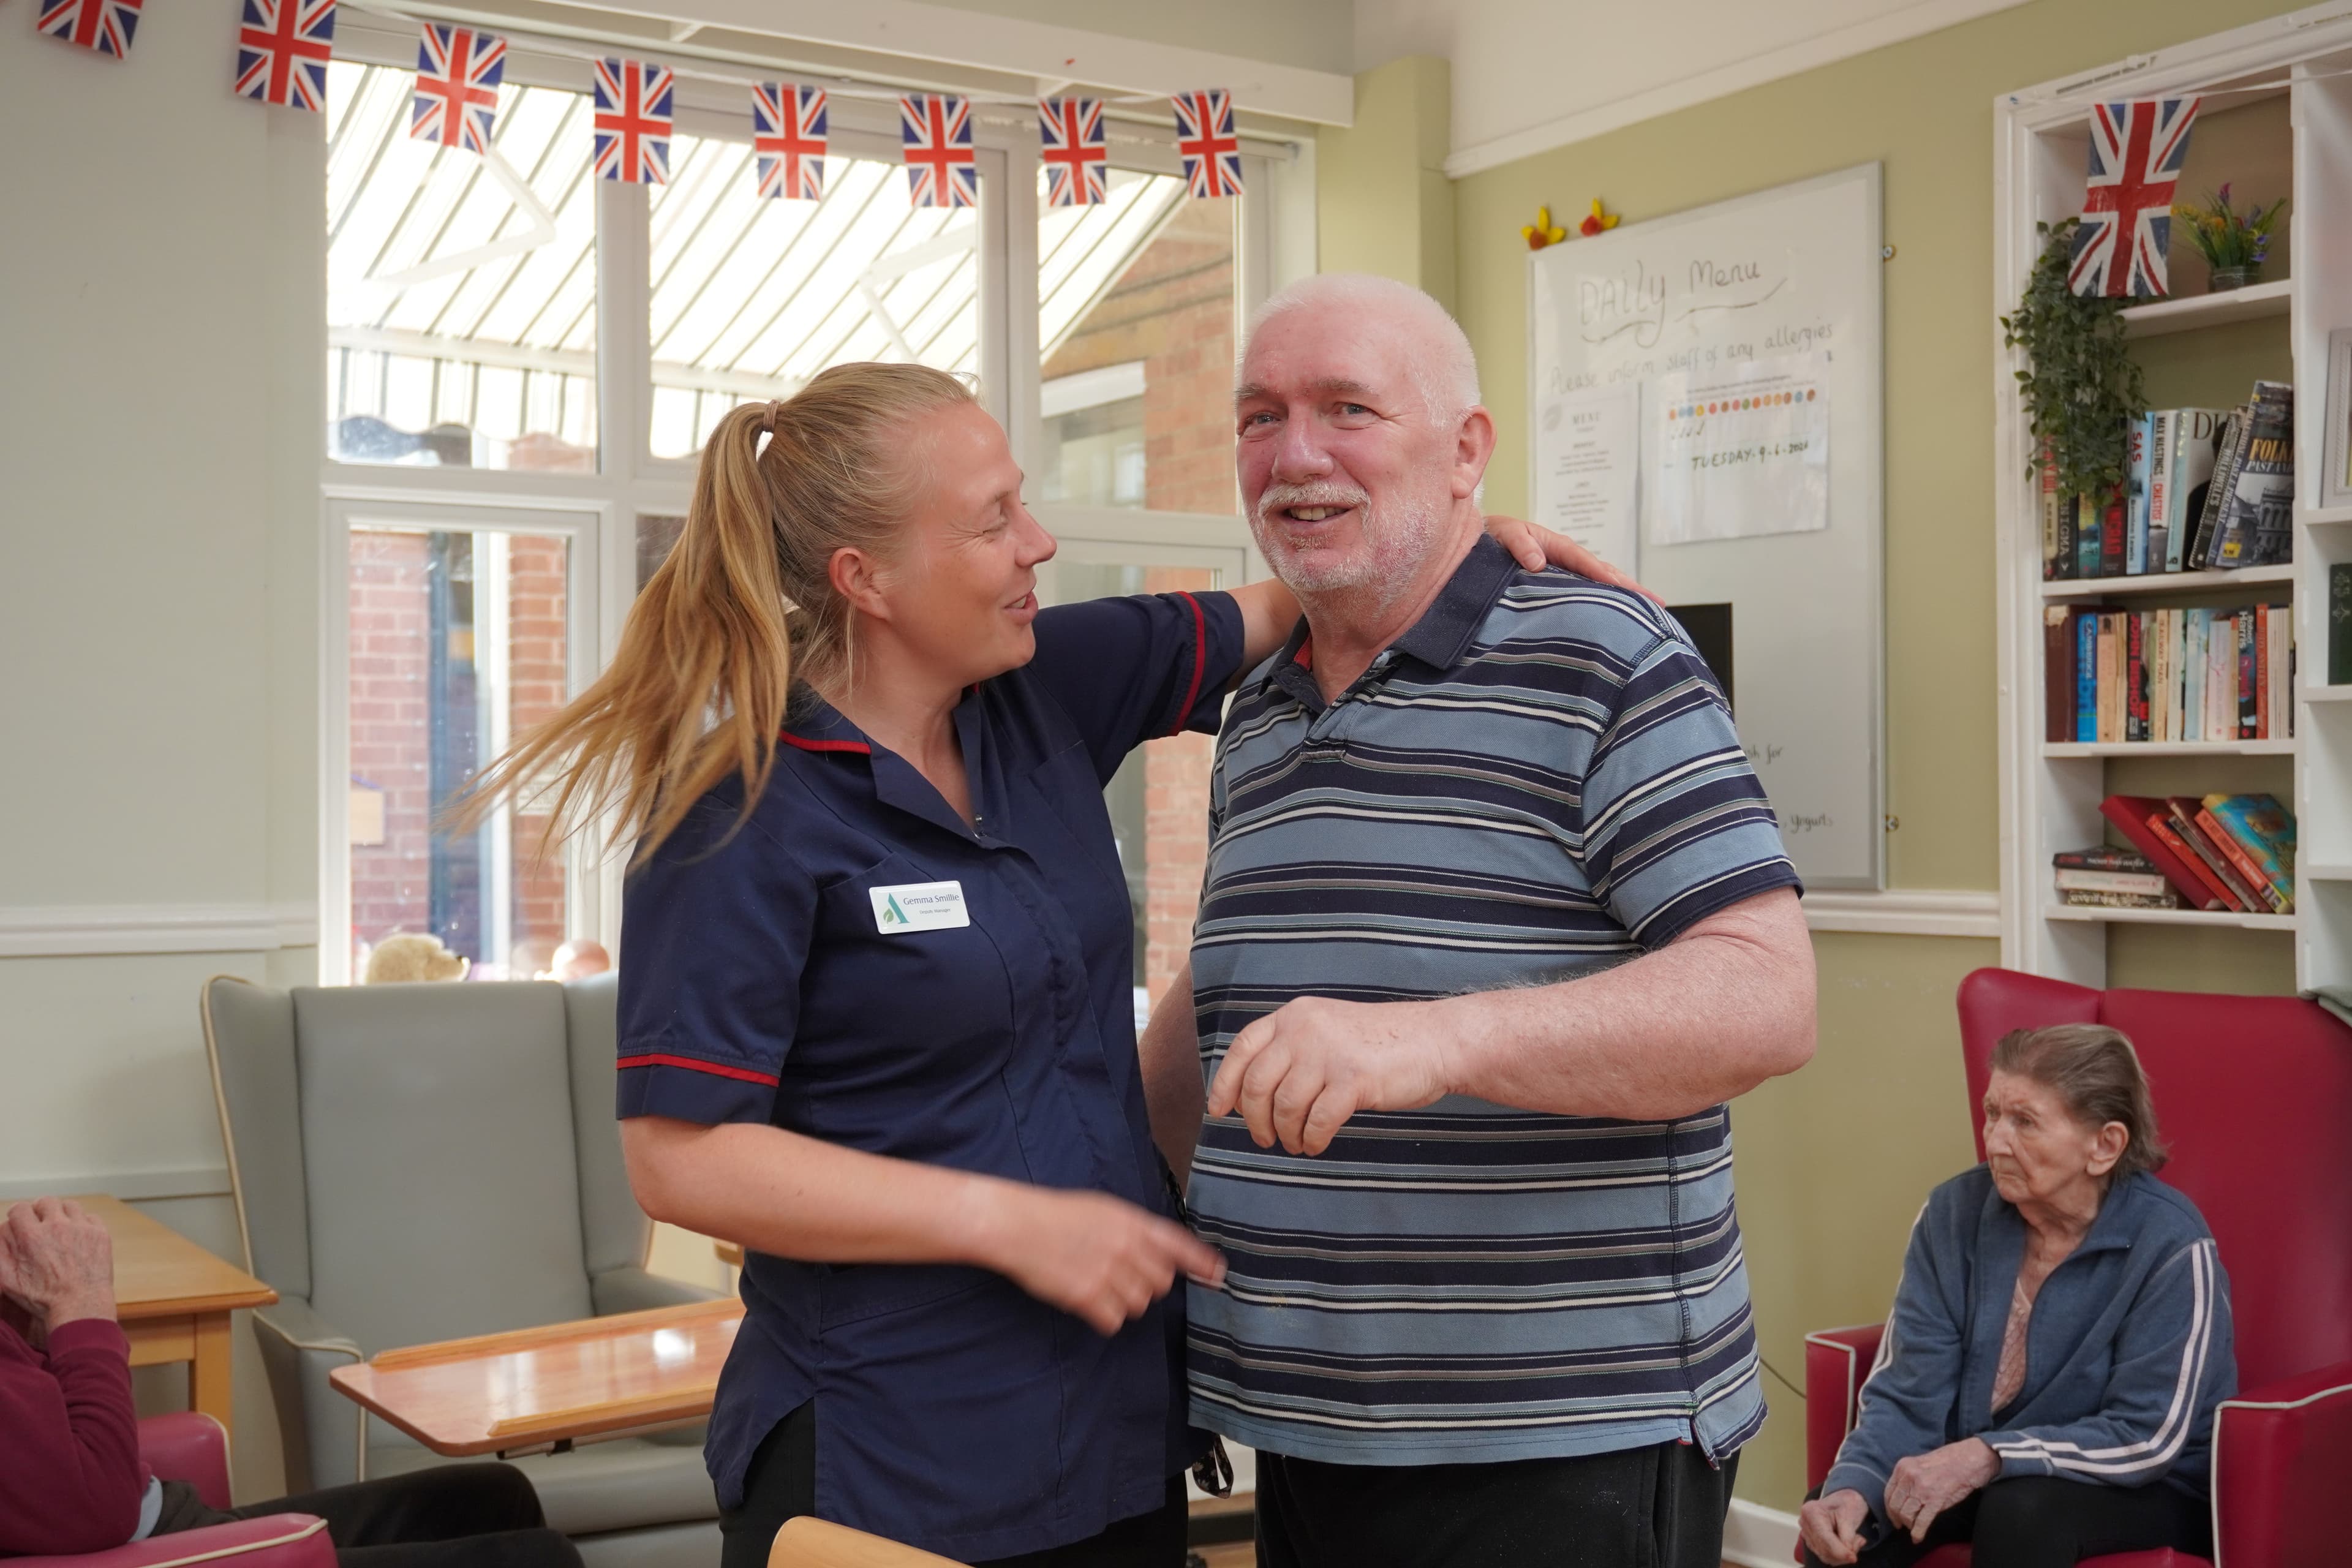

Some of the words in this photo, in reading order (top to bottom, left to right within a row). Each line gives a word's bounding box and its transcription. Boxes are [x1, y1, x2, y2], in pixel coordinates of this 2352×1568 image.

[1690, 260, 1760, 293] Menu
[1551, 366, 1598, 394] Please
[1727, 342, 1754, 361] any
[1765, 315, 1833, 351] allergies
[2132, 432, 2143, 462] SAS
[2239, 611, 2248, 649] Harris
[903, 895, 933, 905] Gemma
[935, 894, 960, 903] Smillie
